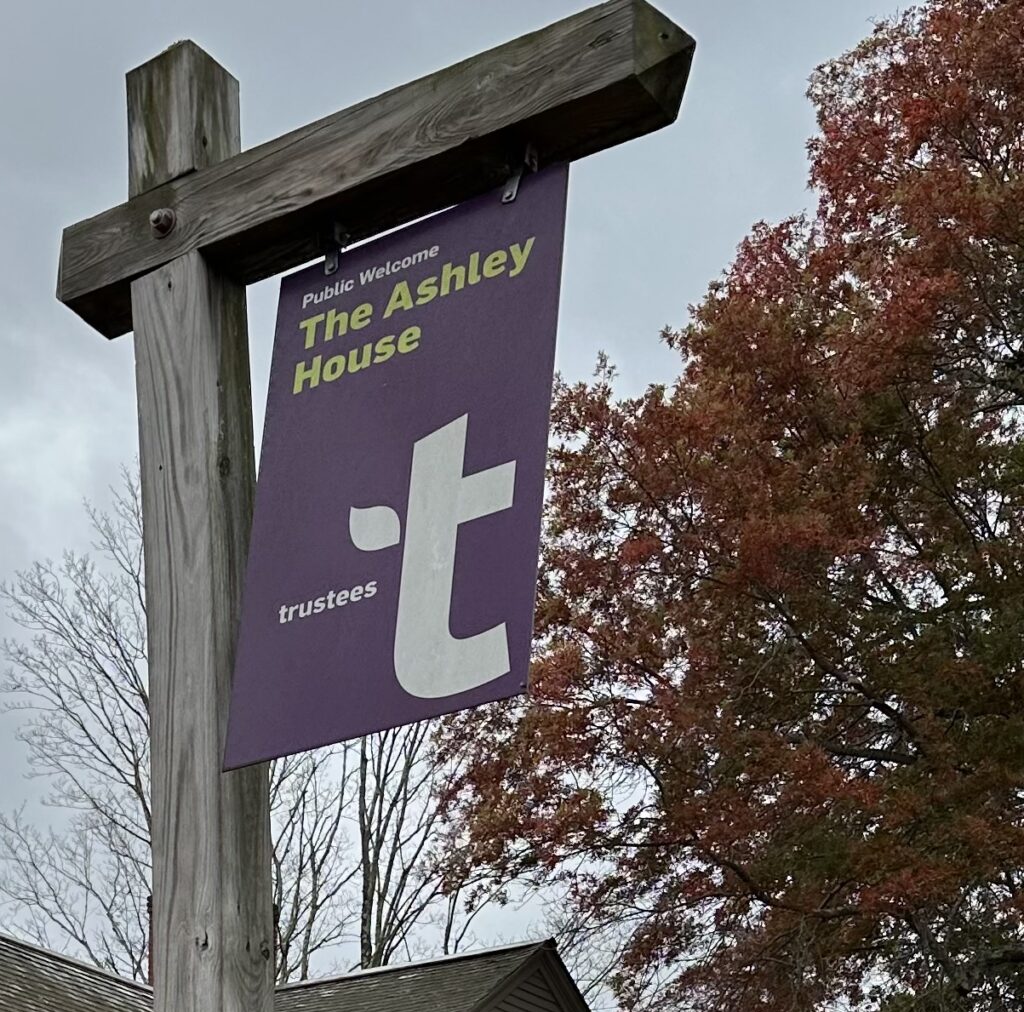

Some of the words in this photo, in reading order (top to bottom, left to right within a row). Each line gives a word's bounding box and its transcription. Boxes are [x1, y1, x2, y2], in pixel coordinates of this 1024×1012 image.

[299, 302, 373, 350] The
[382, 236, 536, 320] Ashley
[302, 277, 355, 309] Public
[359, 243, 440, 288] Welcome
[292, 325, 422, 395] House
[393, 412, 517, 699] t
[278, 580, 378, 624] trustees
